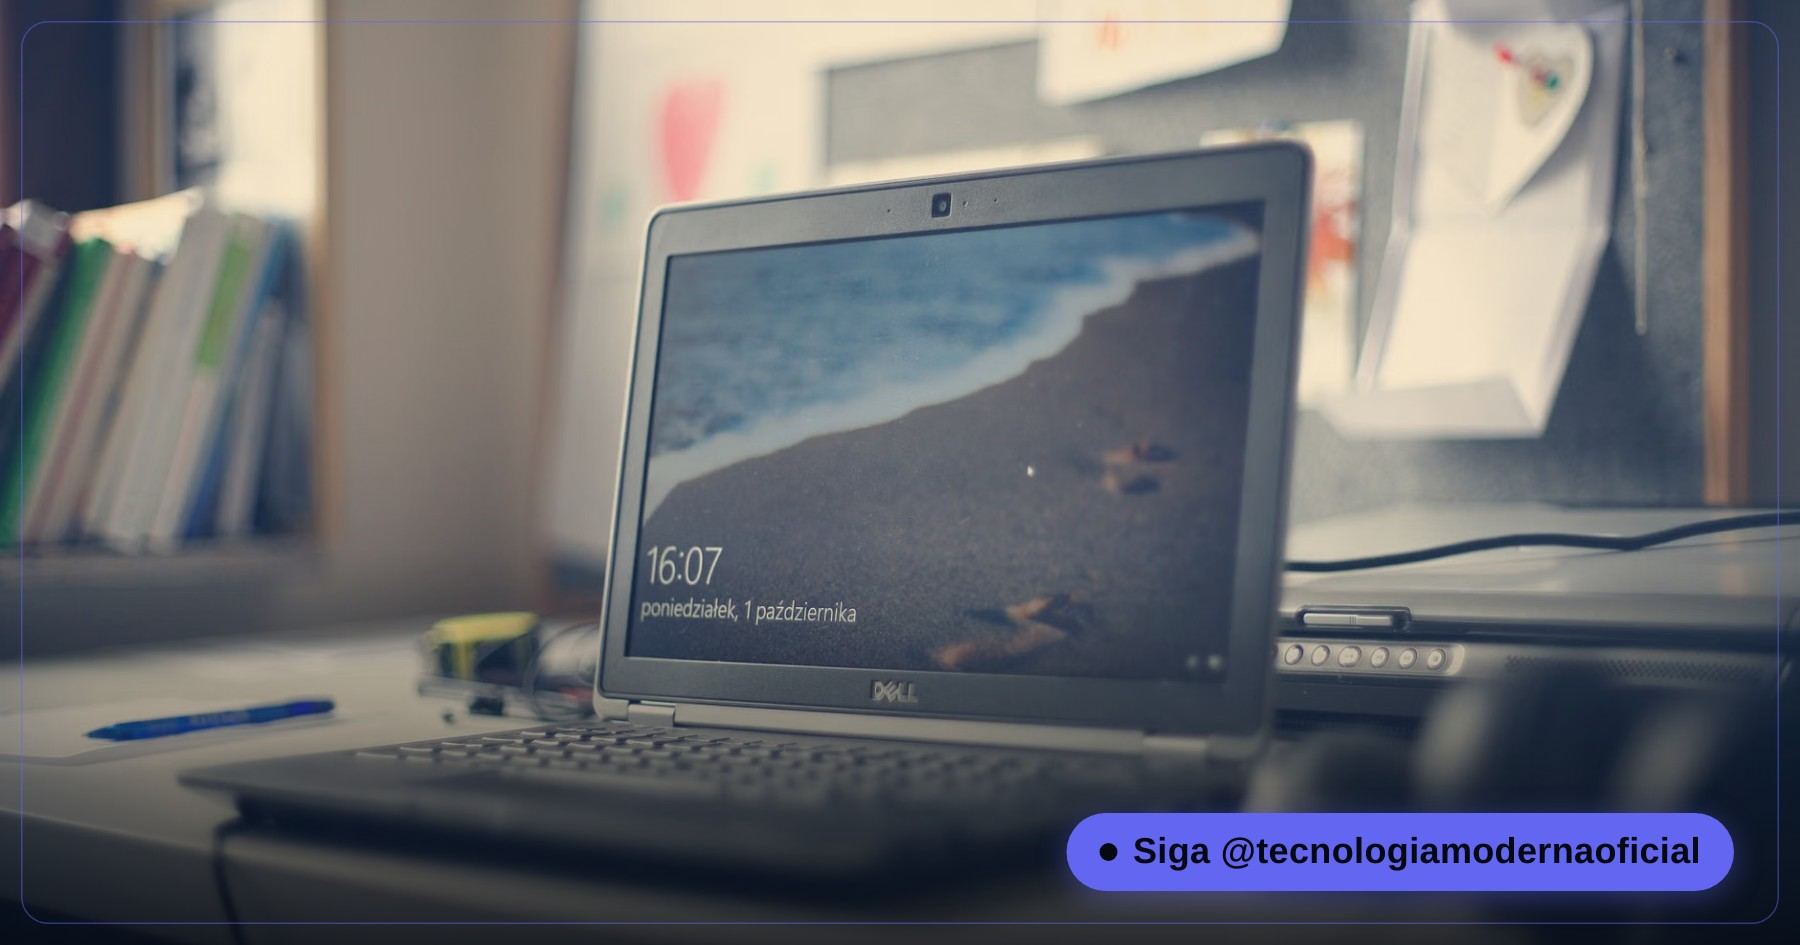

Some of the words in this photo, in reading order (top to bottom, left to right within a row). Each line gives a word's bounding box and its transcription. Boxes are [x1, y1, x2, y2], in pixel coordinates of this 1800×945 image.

[647, 545, 723, 585] 16:07
[640, 597, 739, 622] poniedziałek,
[744, 600, 751, 620] 1
[755, 600, 857, 625] października
[871, 681, 918, 702] DELL
